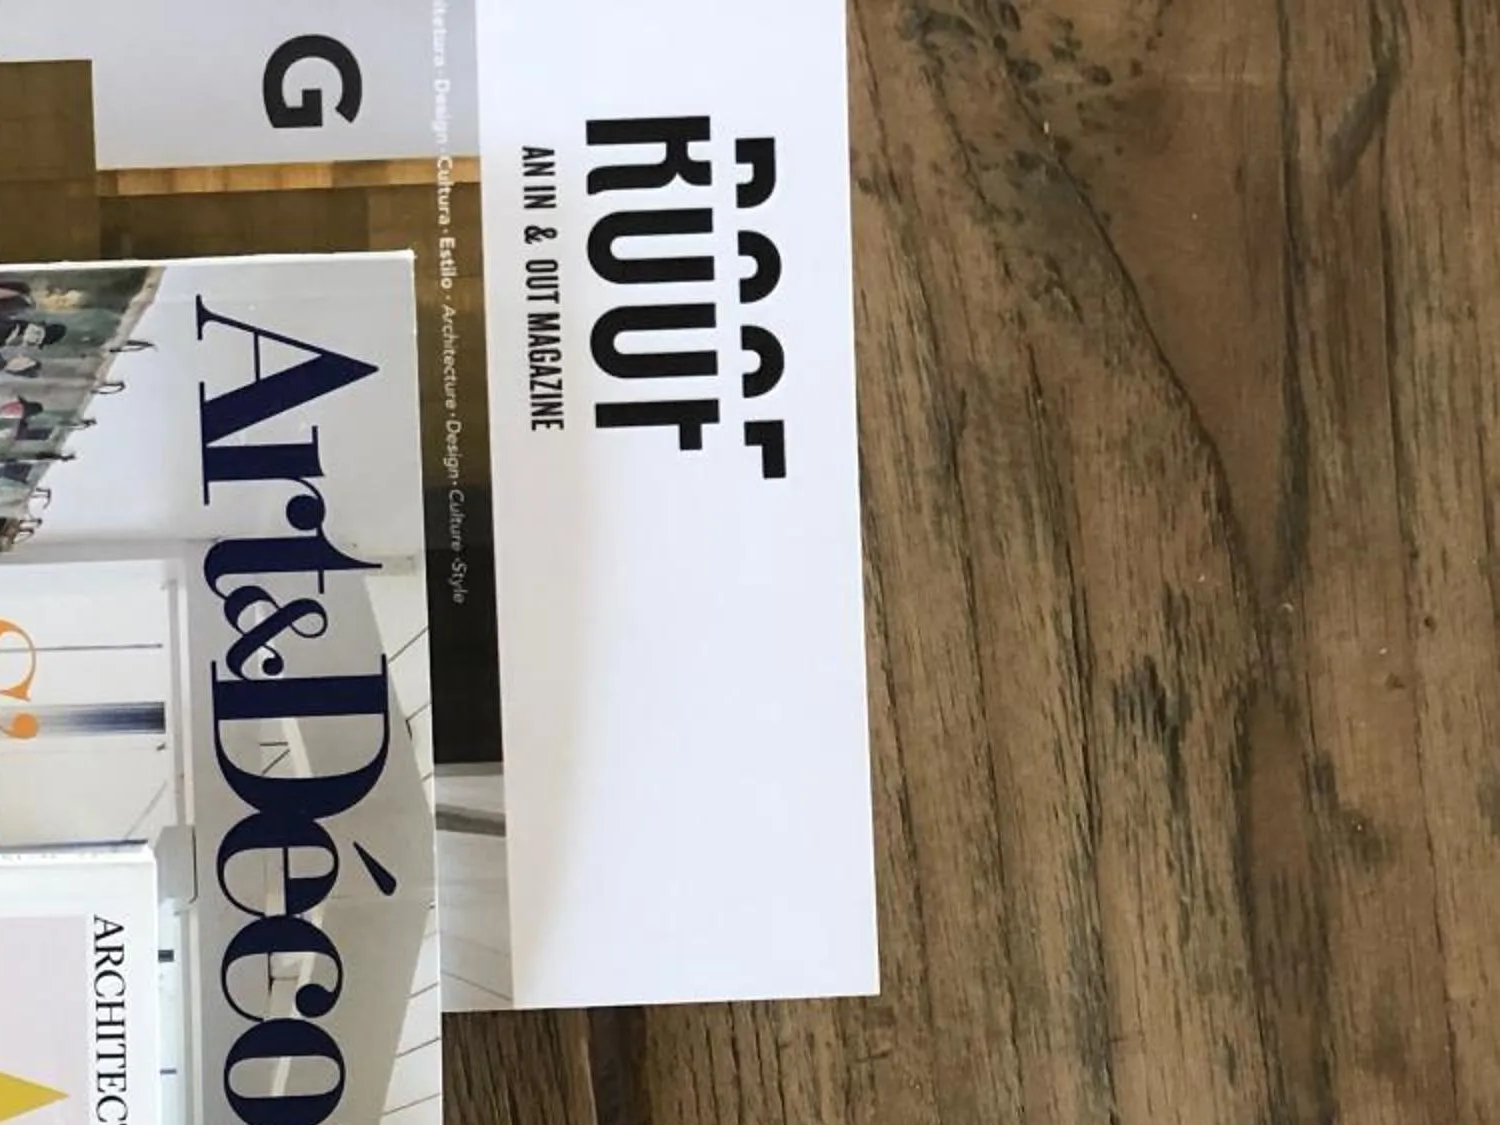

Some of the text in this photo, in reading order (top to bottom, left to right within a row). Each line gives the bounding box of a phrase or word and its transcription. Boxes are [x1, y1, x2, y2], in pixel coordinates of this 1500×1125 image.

[262, 34, 363, 129] G
[436, 156, 455, 226] Cultura
[438, 236, 457, 290] Estilo
[521, 146, 565, 432] AN IN & OUT MAGAZINE
[440, 304, 461, 410] Architecture
[443, 419, 463, 480] Design
[446, 561, 468, 605] Style
